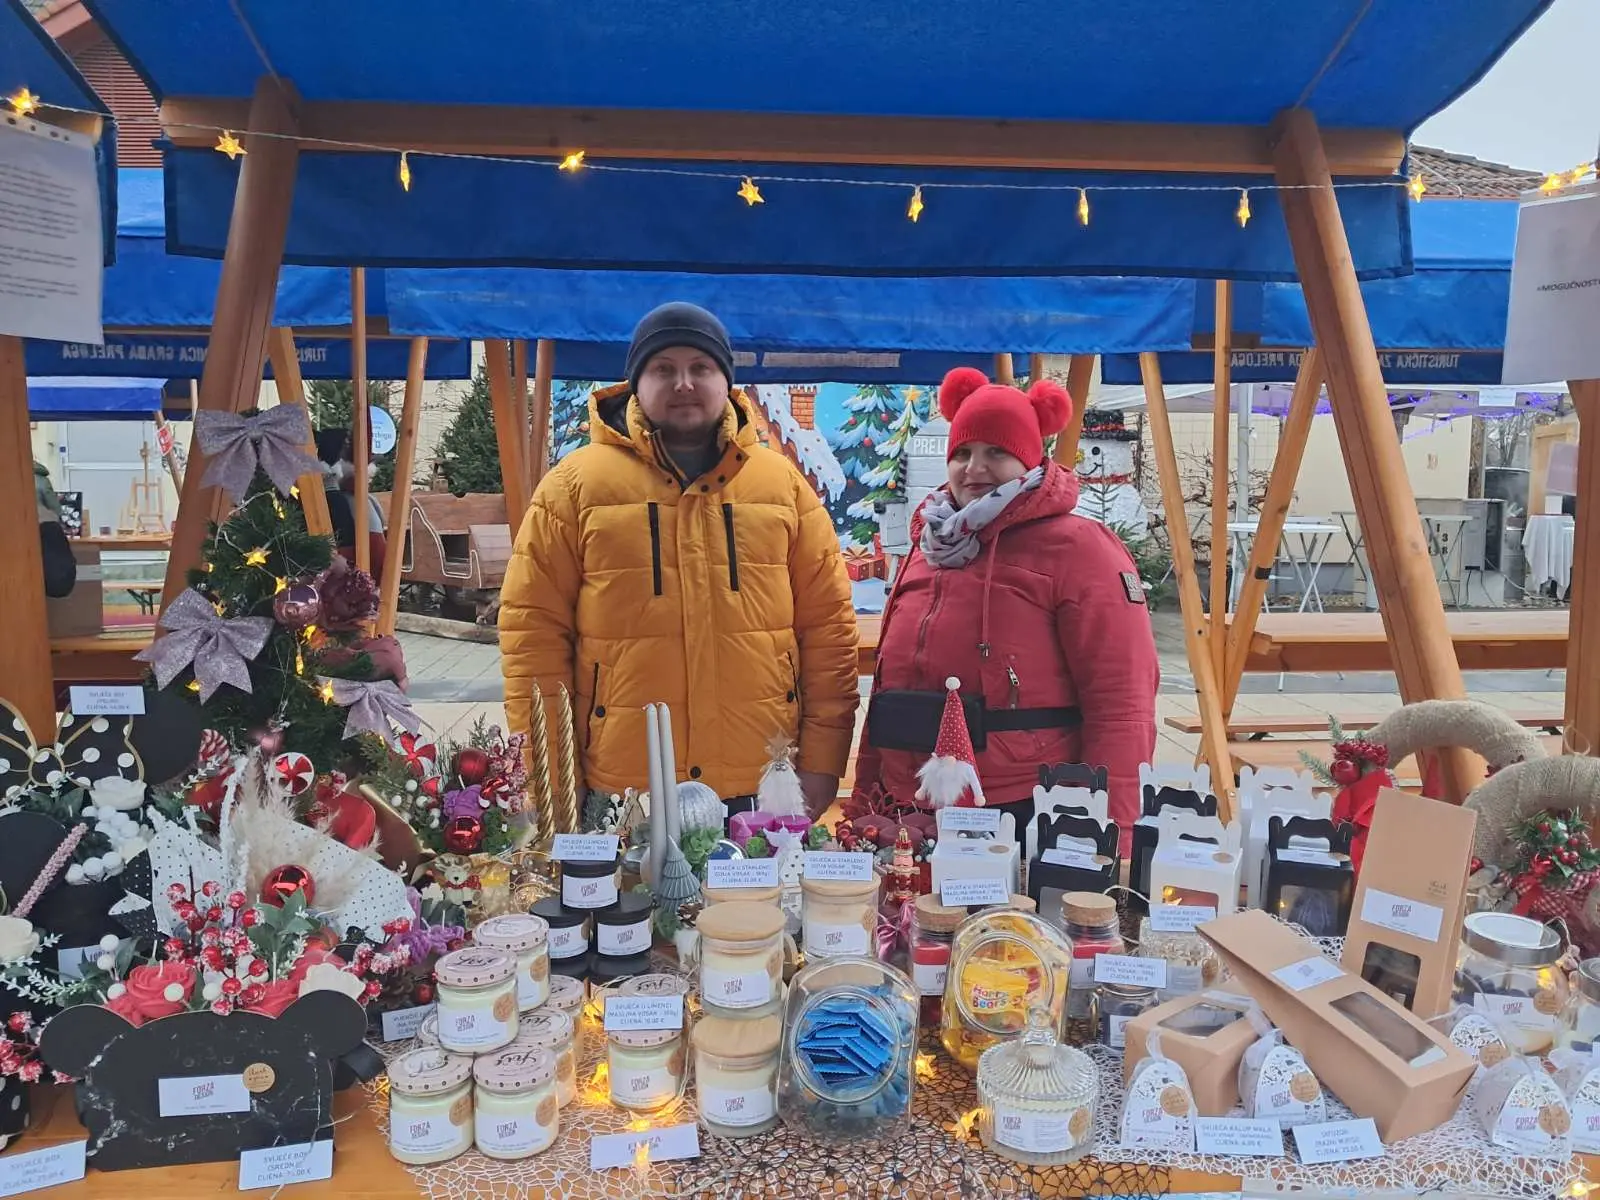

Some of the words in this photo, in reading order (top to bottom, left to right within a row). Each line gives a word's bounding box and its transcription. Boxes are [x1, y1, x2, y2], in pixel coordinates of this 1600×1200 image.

[914, 438, 949, 455] PREL
[409, 1120, 432, 1134] FORZA
[496, 1120, 519, 1133] FORZA
